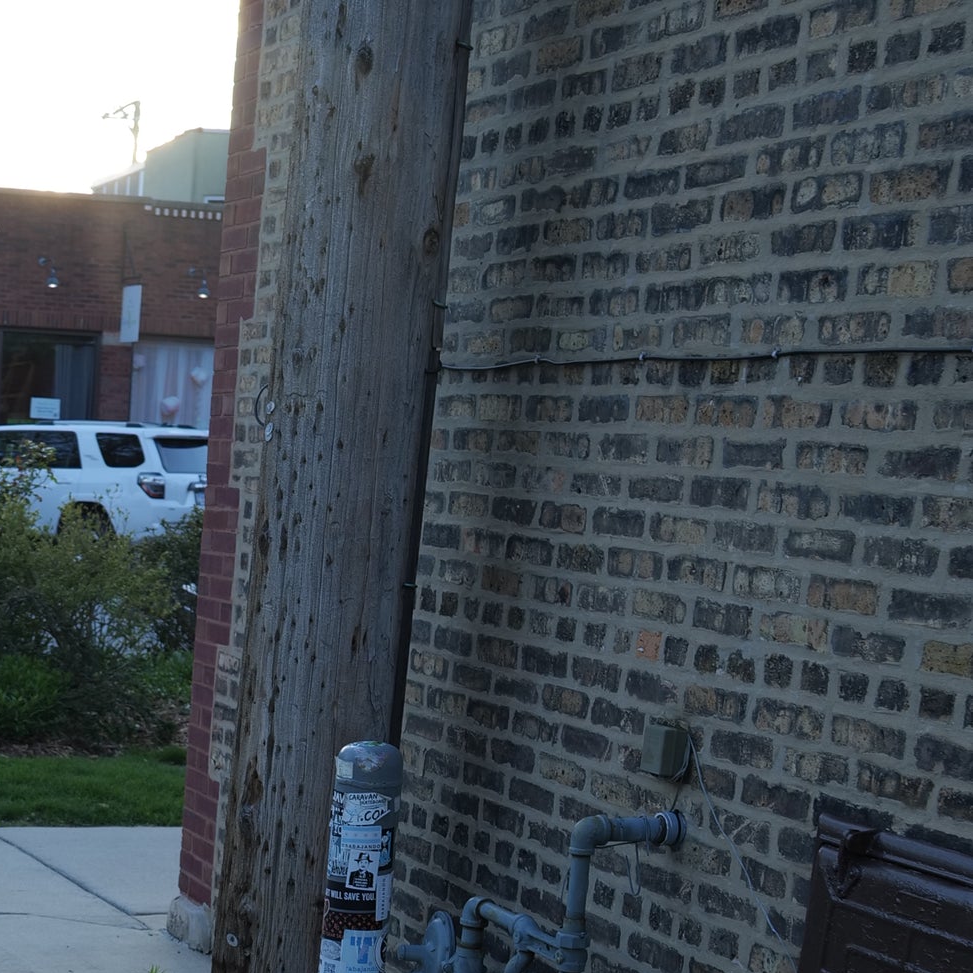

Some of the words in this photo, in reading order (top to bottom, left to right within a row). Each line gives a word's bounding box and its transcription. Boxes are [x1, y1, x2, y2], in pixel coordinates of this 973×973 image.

[348, 793, 378, 801] CARAVAN
[330, 889, 343, 900] WILL
[343, 891, 361, 901] SAVE
